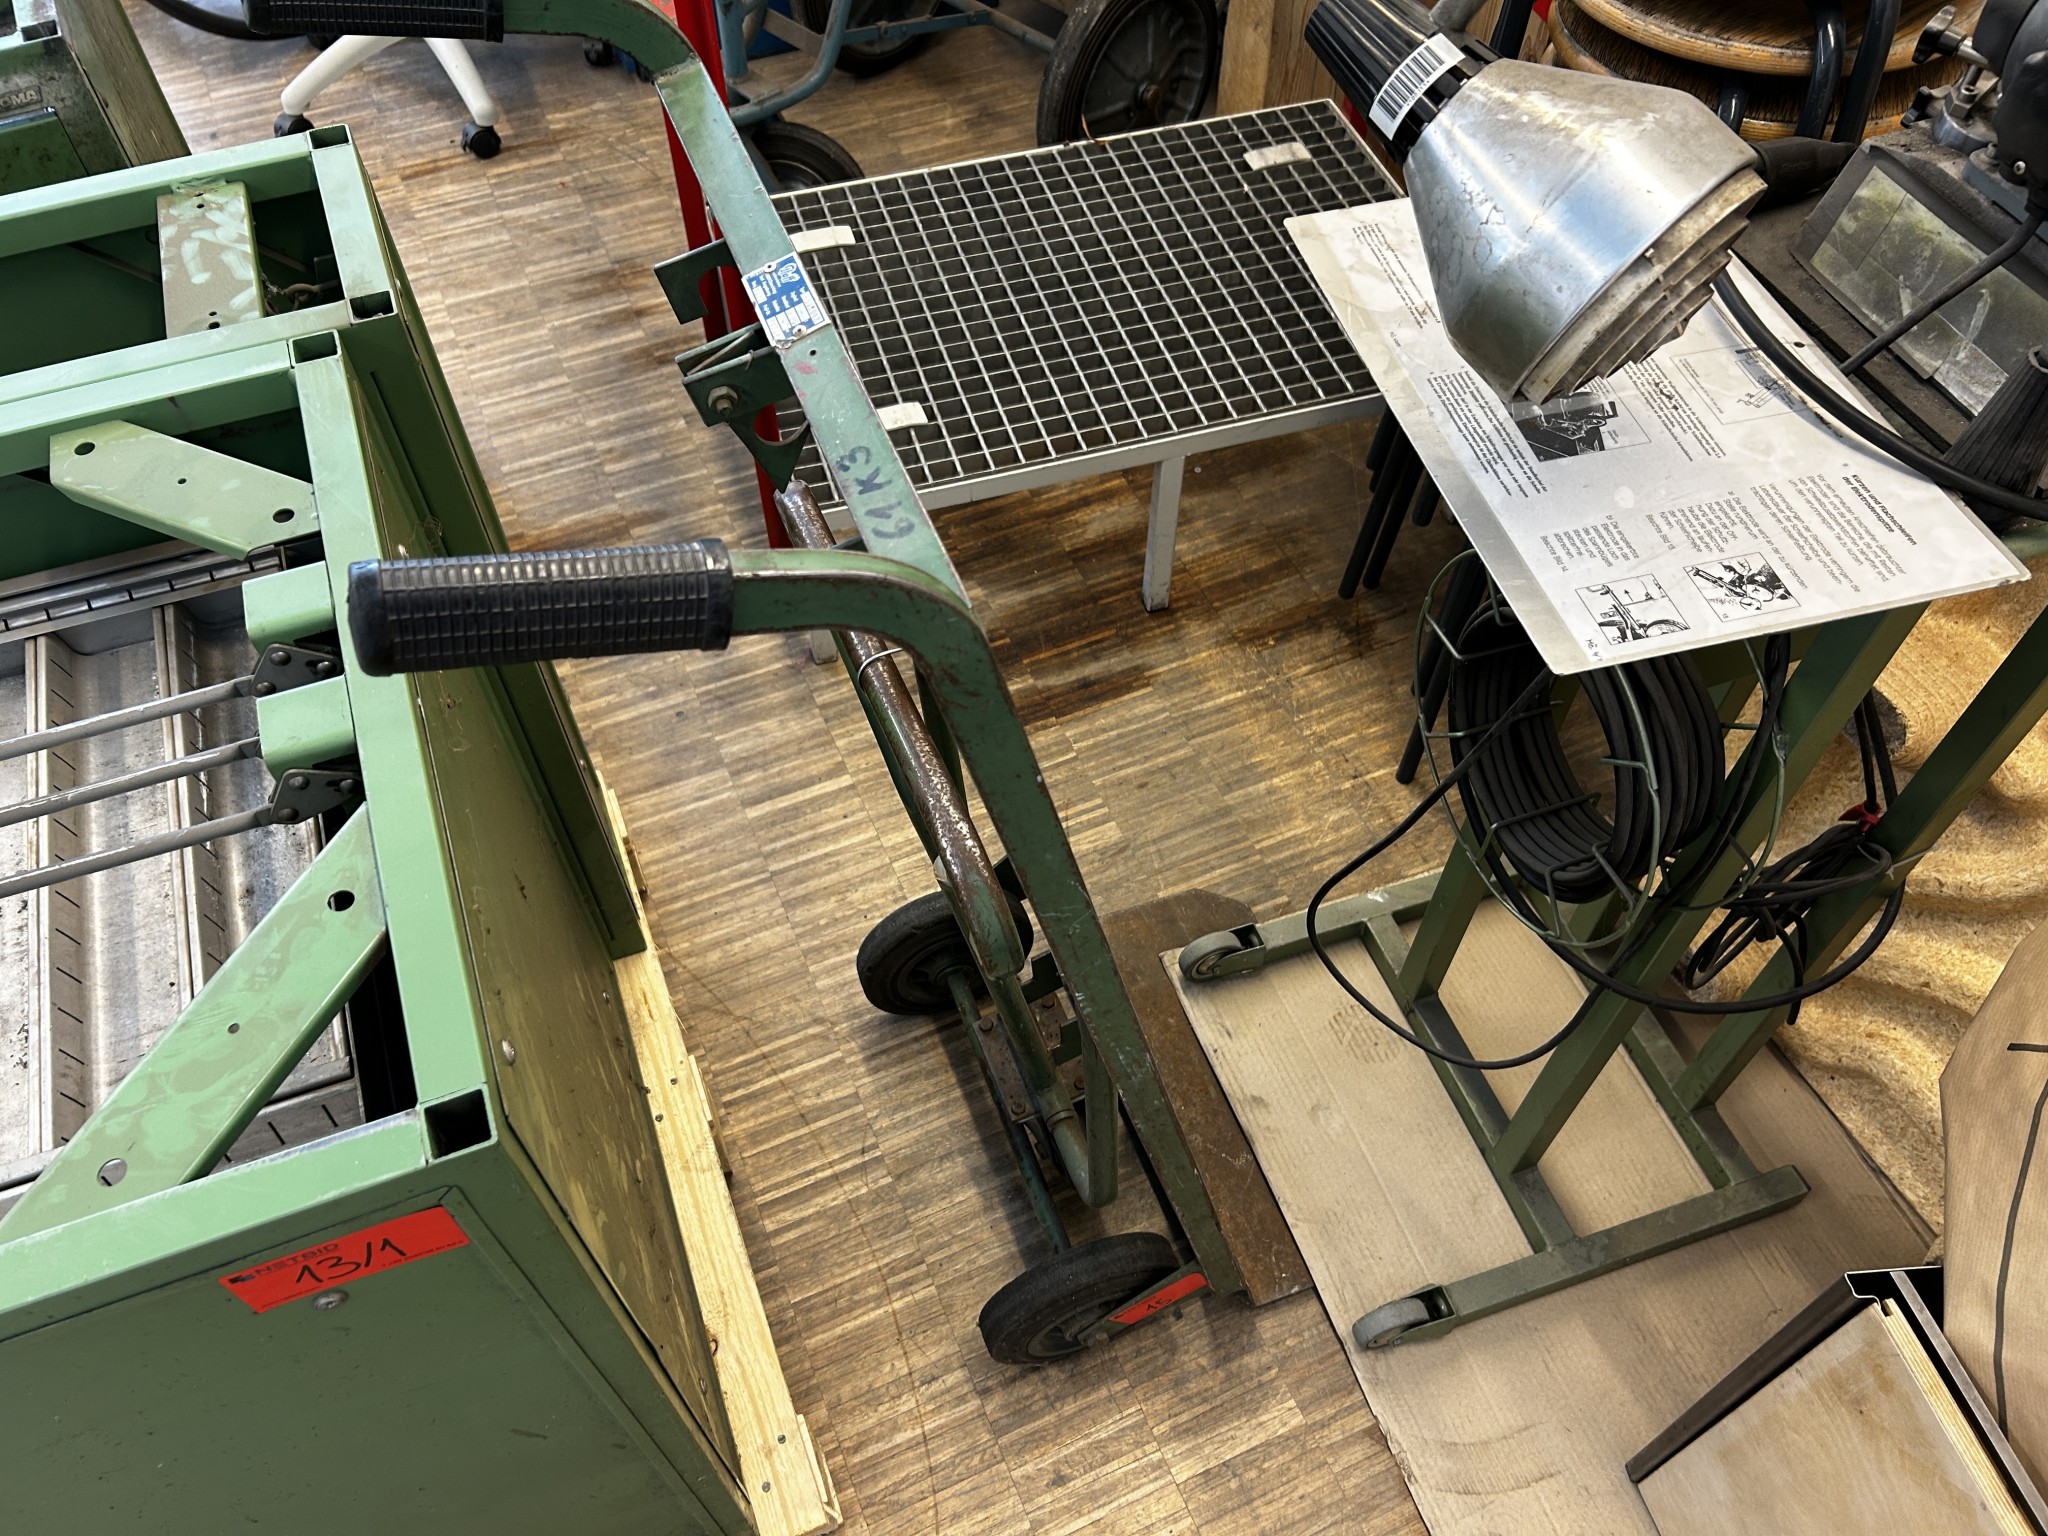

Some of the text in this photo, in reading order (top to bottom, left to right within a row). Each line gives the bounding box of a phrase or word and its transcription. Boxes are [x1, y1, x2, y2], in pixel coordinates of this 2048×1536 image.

[1668, 510, 1678, 518] der
[1677, 508, 1695, 527] drehend
[1696, 504, 1708, 517] nung
[1705, 503, 1716, 514] Dazu
[1723, 499, 1736, 511] Stelle
[1769, 512, 1783, 524] deren
[1795, 488, 1806, 496] den
[1804, 498, 1835, 530] verunreinigten
[1834, 532, 1843, 540] Teil
[1842, 476, 1894, 532] der Elektrodenspitze
[1852, 474, 1870, 493] Kürzen
[1868, 494, 1882, 504] und
[1879, 506, 1916, 545] Flachschleifen
[1582, 527, 1591, 536] des
[1610, 521, 1619, 529] Die
[1646, 514, 1662, 533] Beachte
[1660, 534, 1670, 543] Bild
[1687, 506, 1700, 521] haube
[1704, 530, 1724, 552] Elektrode
[1759, 485, 1785, 514] Lebensdauer
[1783, 515, 1793, 523] der
[1790, 524, 1820, 557] Schleifscheibe
[1818, 558, 1830, 568] und
[1798, 478, 1808, 486] von
[1857, 548, 1879, 569] behaftet
[1807, 476, 1830, 499] Elektroden
[1828, 500, 1840, 509] sind
[1870, 550, 1881, 558] mit
[1879, 559, 1896, 576] Resten
[1824, 483, 1836, 492] dem
[1833, 494, 1854, 515] erneuten
[1854, 516, 1878, 542] Anschleifen
[1876, 544, 1905, 573] gebrauchter
[1540, 536, 1556, 555] Beachte
[1553, 556, 1564, 565] Bild
[1572, 529, 1596, 558] stecken und
[1591, 525, 1619, 560] passende Loch
[1601, 523, 1619, 545] Elektrode
[1620, 552, 1630, 561] das
[1732, 497, 1742, 505] Die
[1739, 506, 1759, 527] Elektrode
[1757, 528, 1769, 539] wird
[1771, 546, 1781, 554] der
[1785, 563, 1807, 588] kürzenden
[1810, 534, 1831, 556] Elektrode
[1830, 558, 1853, 583] verringern
[1850, 584, 1860, 592] die
[295, 1237, 407, 1284] 13/1
